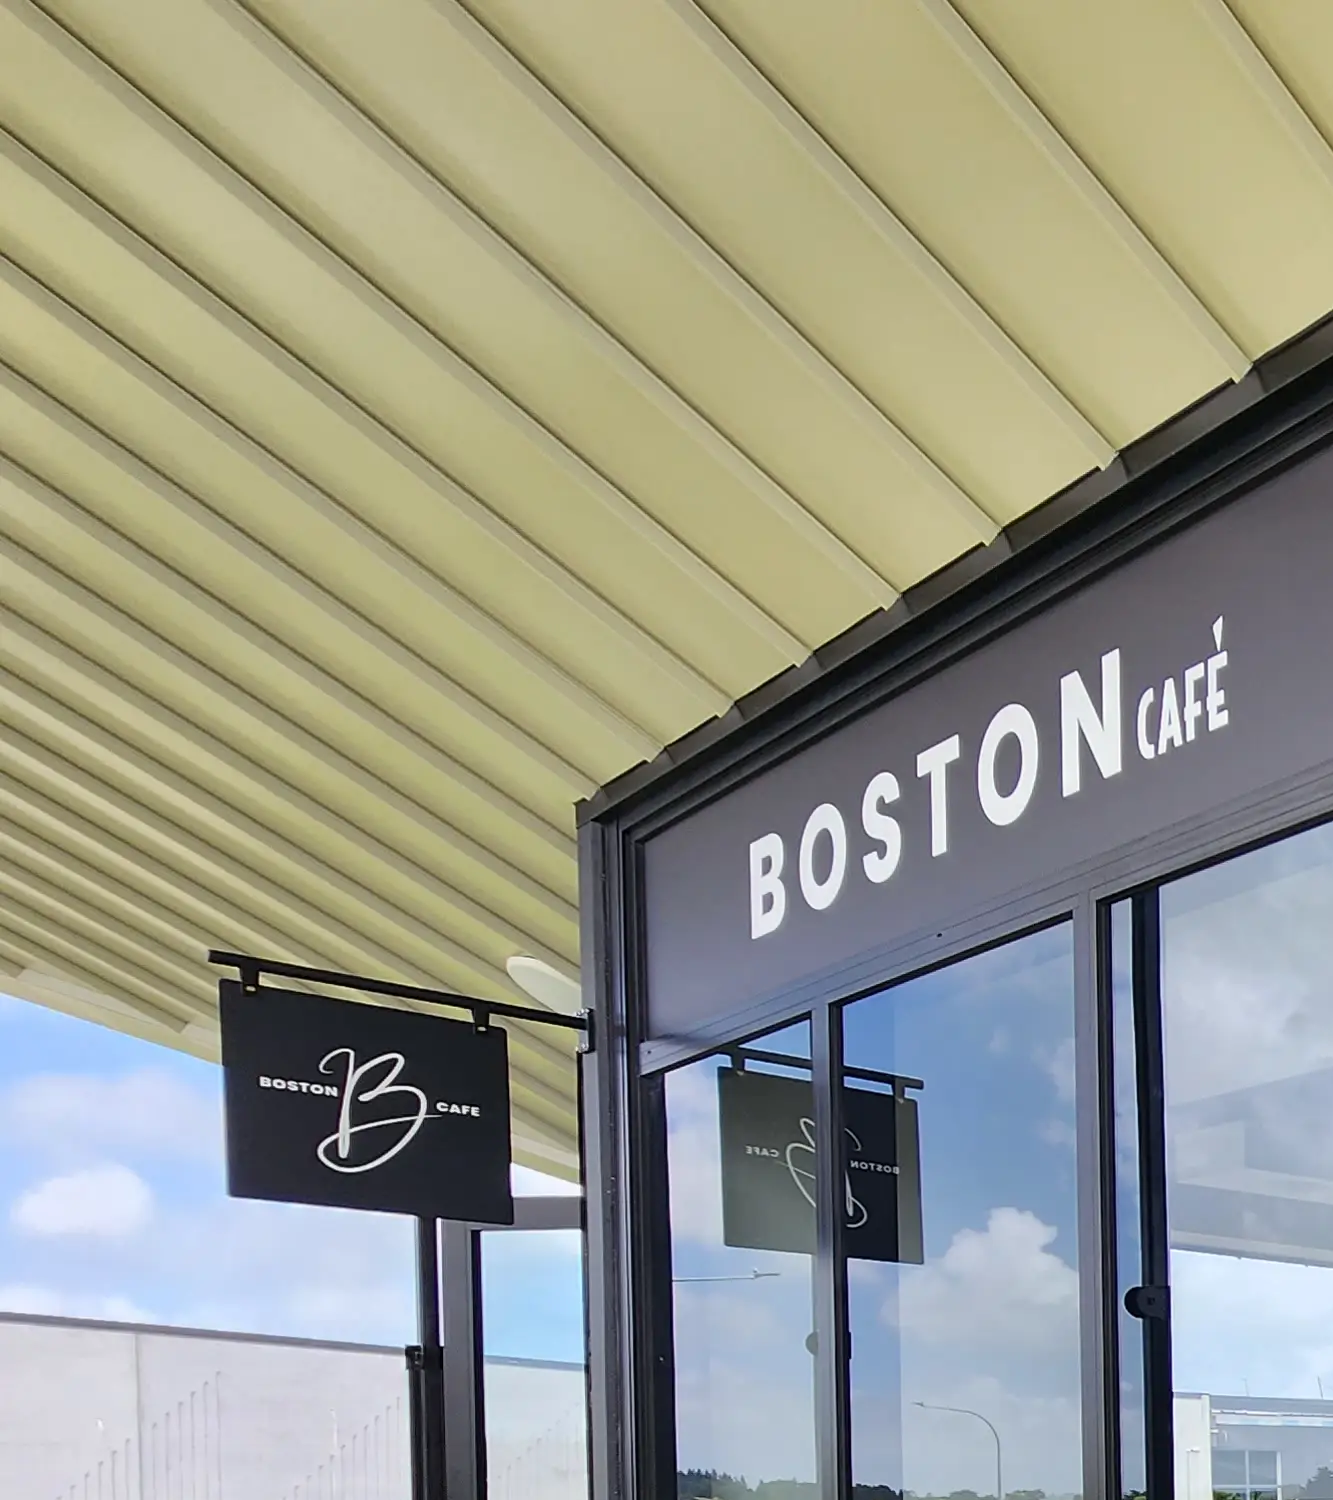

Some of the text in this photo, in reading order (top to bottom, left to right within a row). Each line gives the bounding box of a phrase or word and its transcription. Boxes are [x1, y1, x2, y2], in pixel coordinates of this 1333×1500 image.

[749, 615, 1229, 940] BOSTON CAFÉ
[259, 1076, 338, 1097] BOSTON
[436, 1101, 480, 1117] CAFE
